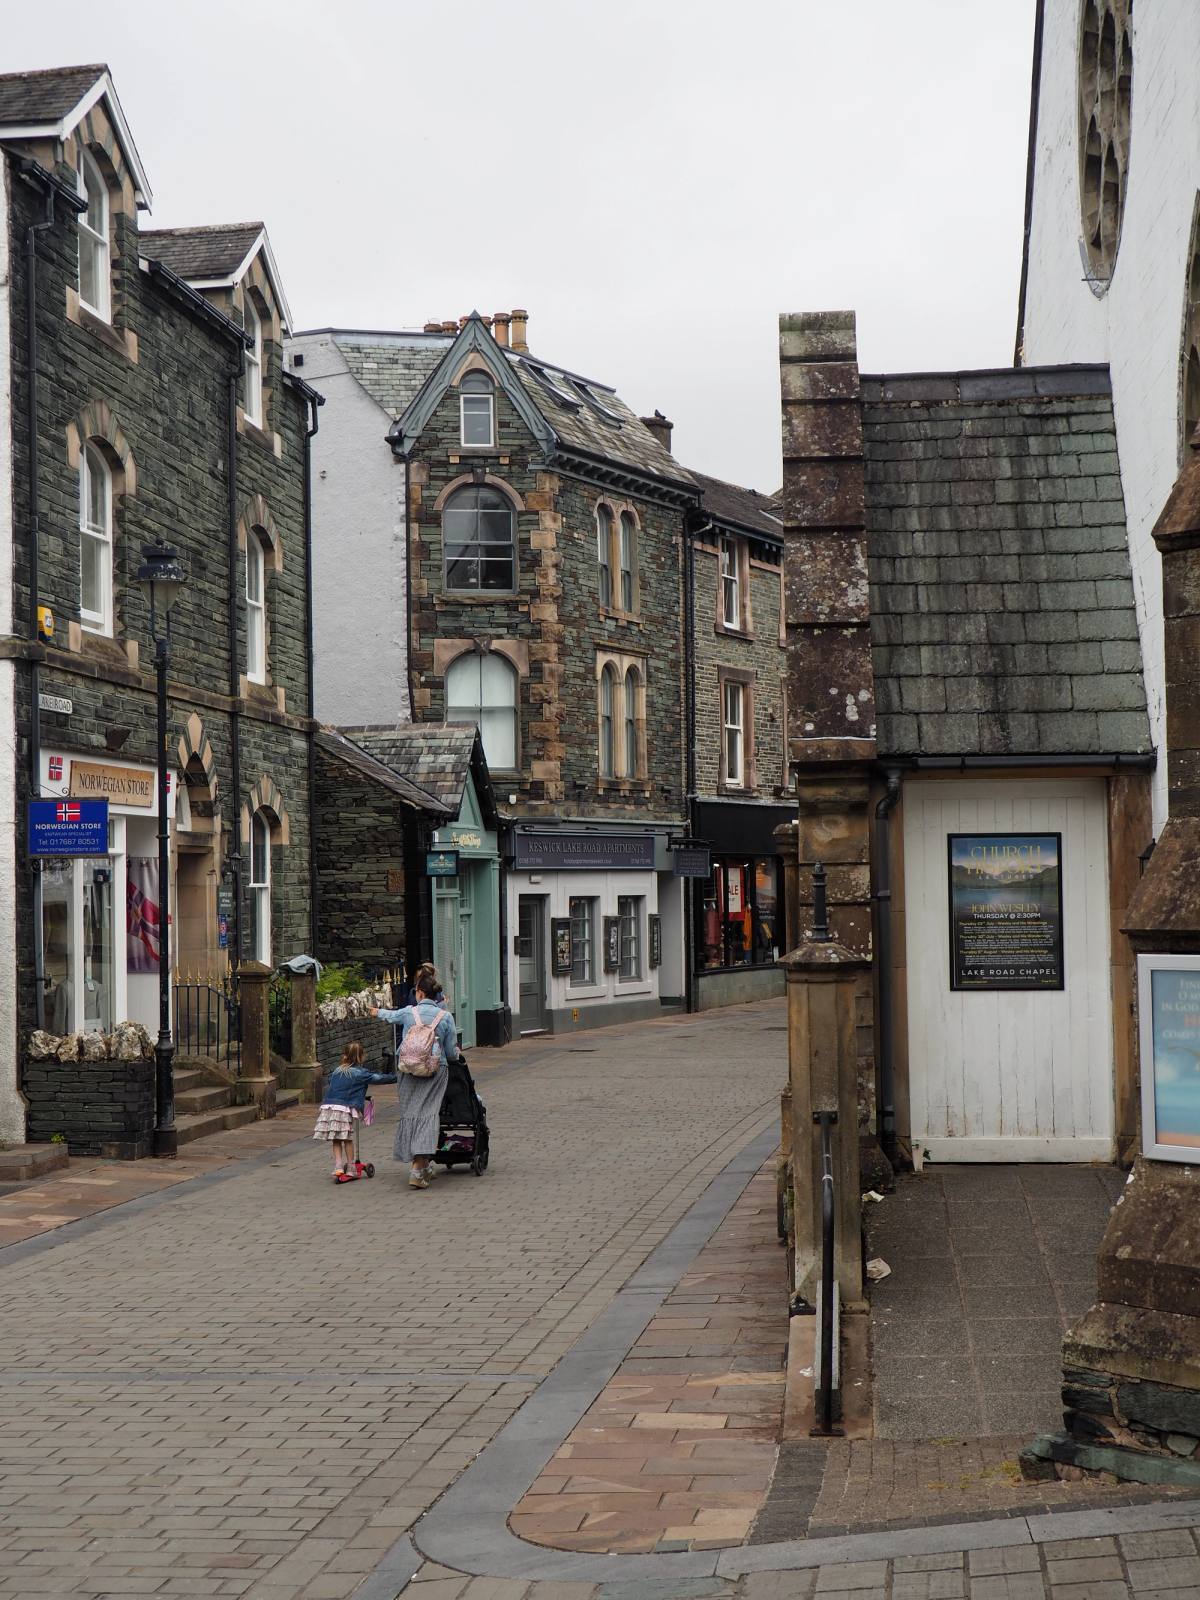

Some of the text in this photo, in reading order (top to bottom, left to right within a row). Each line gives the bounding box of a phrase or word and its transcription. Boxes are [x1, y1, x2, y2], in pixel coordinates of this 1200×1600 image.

[55, 698, 71, 712] ROAD
[79, 773, 149, 796] NORWEGIAN STORE
[528, 841, 644, 854] KESWICK LAKE ROAD APARTMENTS
[971, 845, 1040, 861] CHURCH
[971, 903, 1041, 913] JOHN WESLEY
